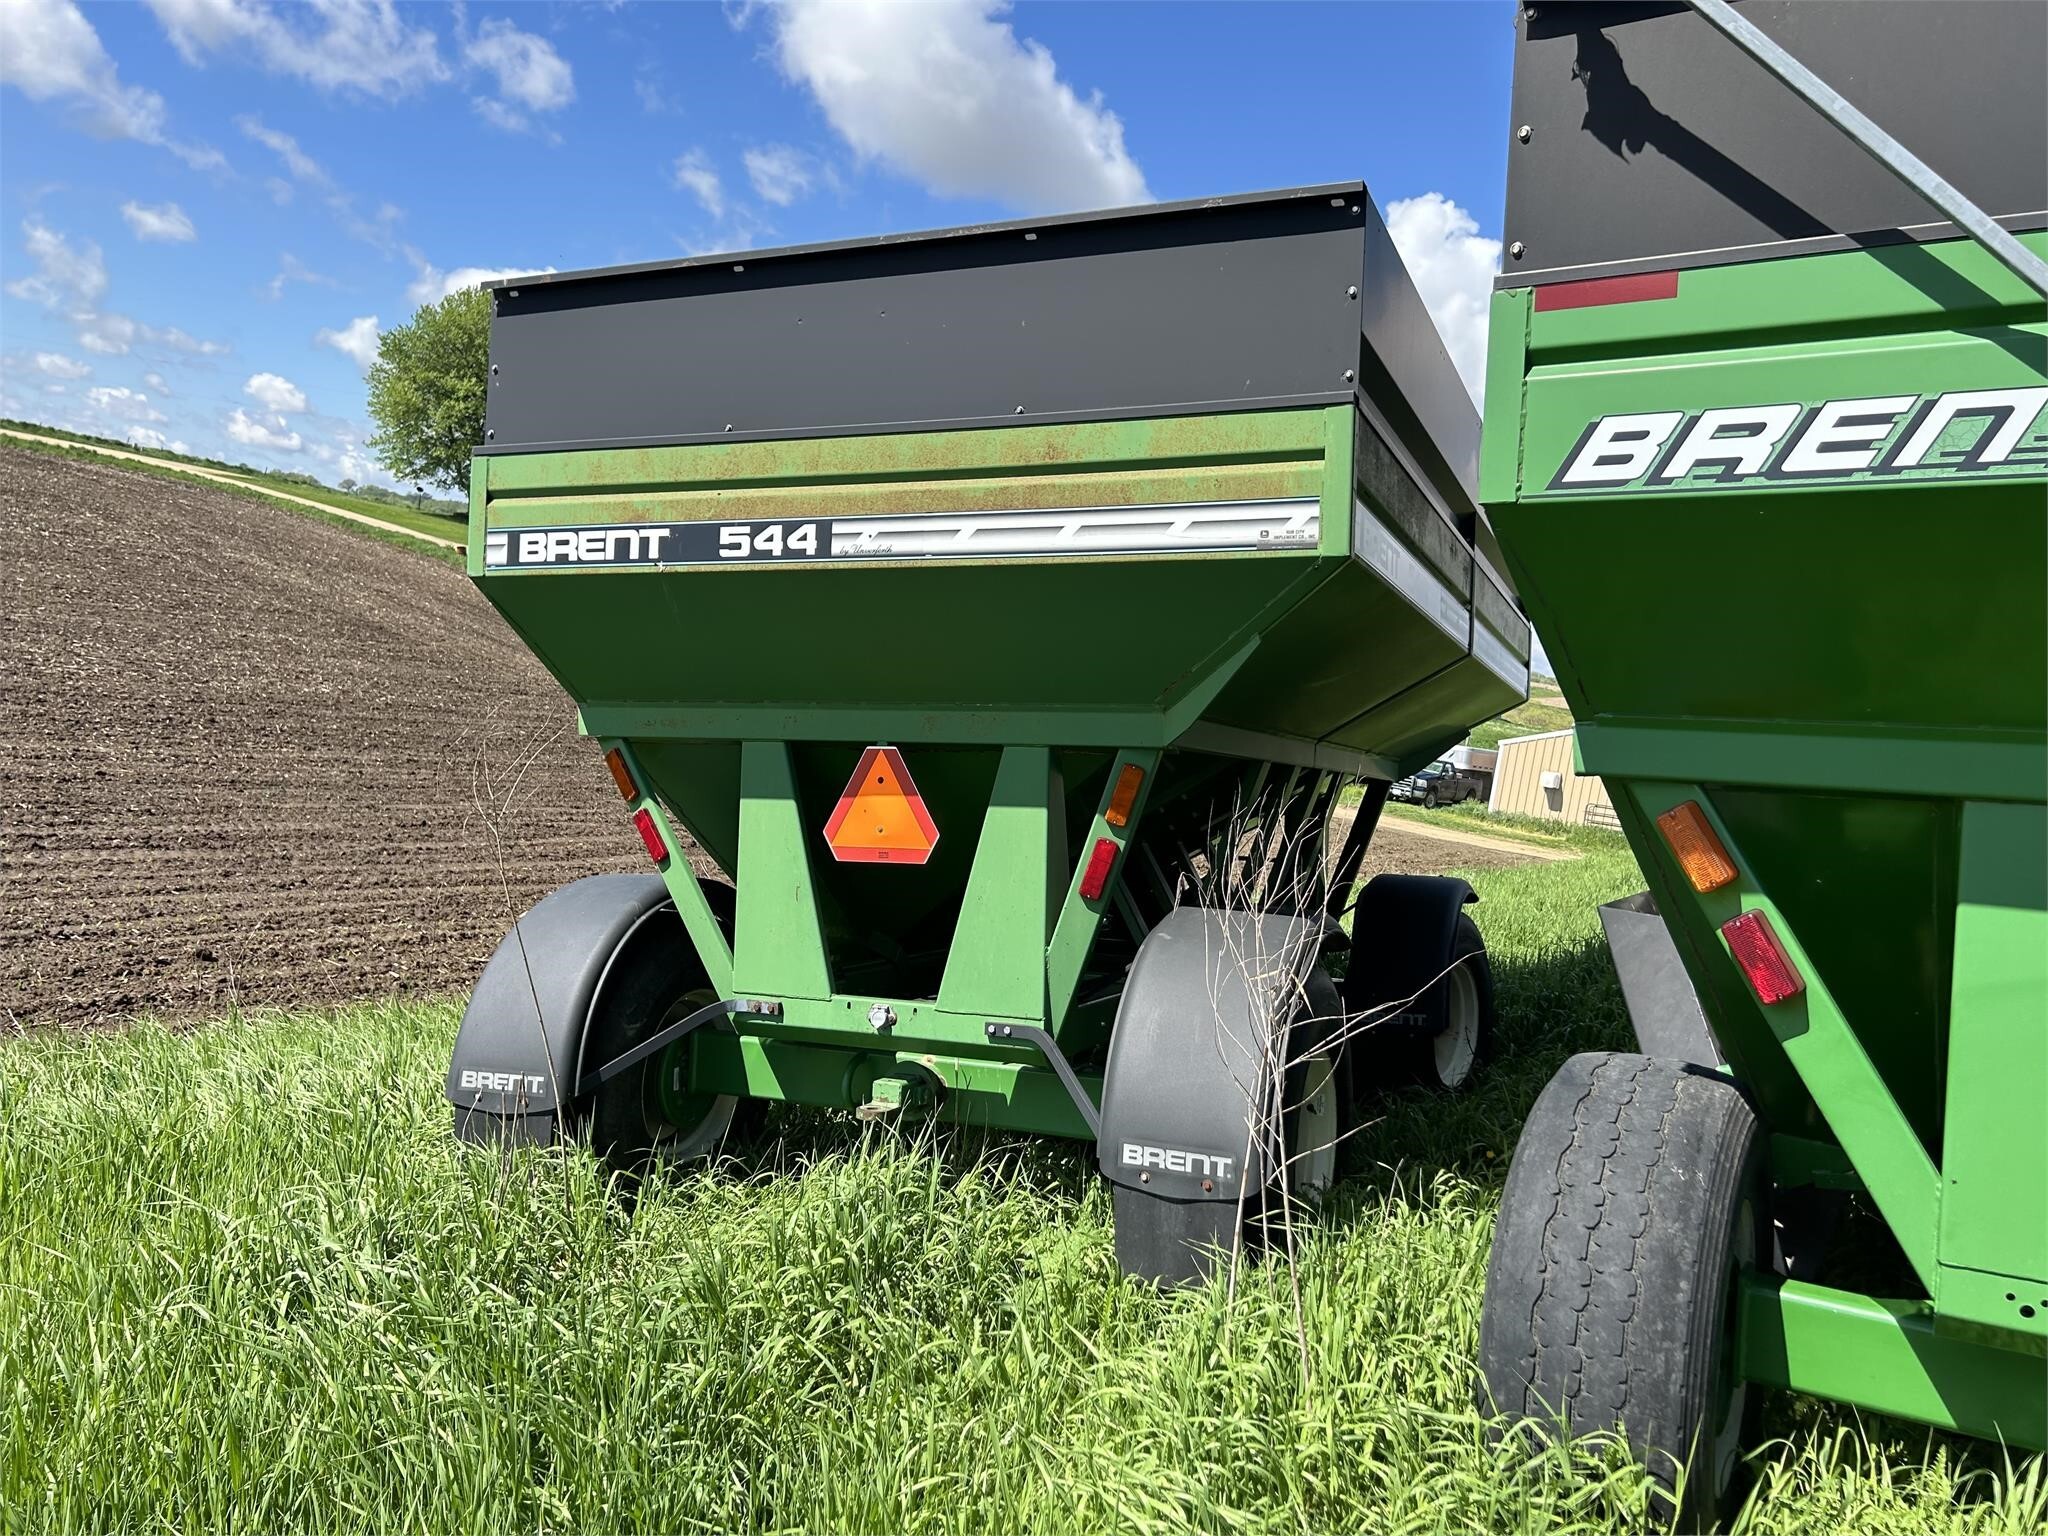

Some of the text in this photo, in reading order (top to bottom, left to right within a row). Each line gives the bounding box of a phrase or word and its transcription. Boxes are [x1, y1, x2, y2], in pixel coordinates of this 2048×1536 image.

[518, 523, 818, 563] BRENT 544
[839, 545, 849, 556] by
[461, 1070, 545, 1093] BRENT
[1122, 1143, 1232, 1178] BRENT
